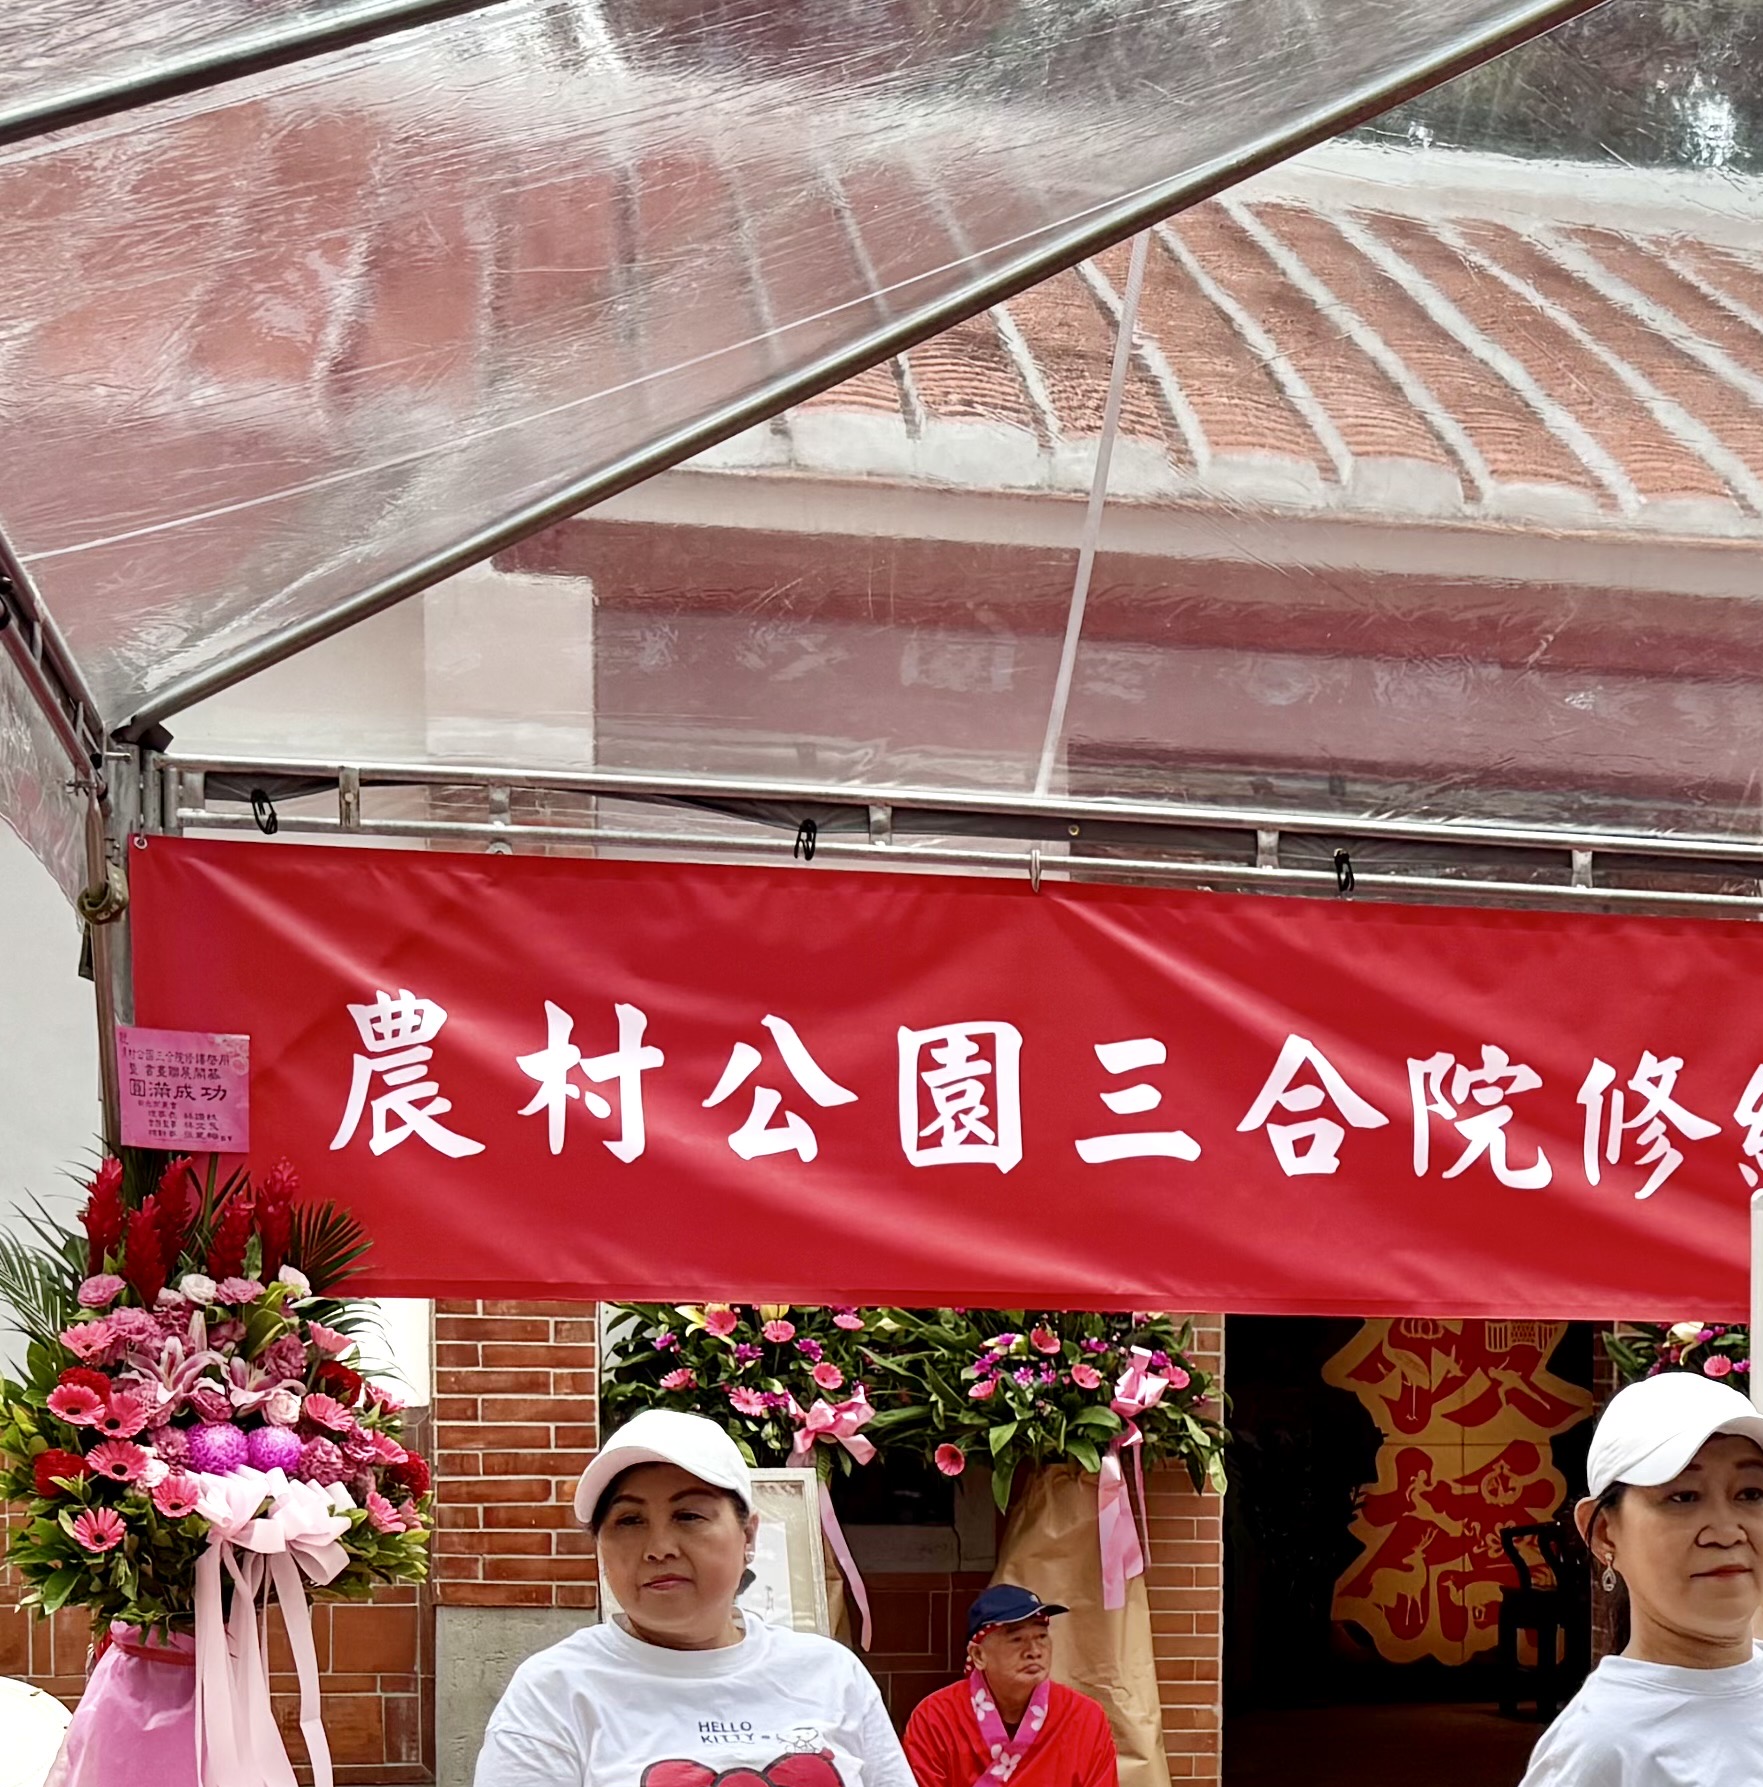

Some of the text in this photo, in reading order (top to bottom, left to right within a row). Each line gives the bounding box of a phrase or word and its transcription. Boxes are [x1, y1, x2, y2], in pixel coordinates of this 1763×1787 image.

[129, 1077, 228, 1102] 圓滿成功
[698, 1721, 752, 1733] HELLO
